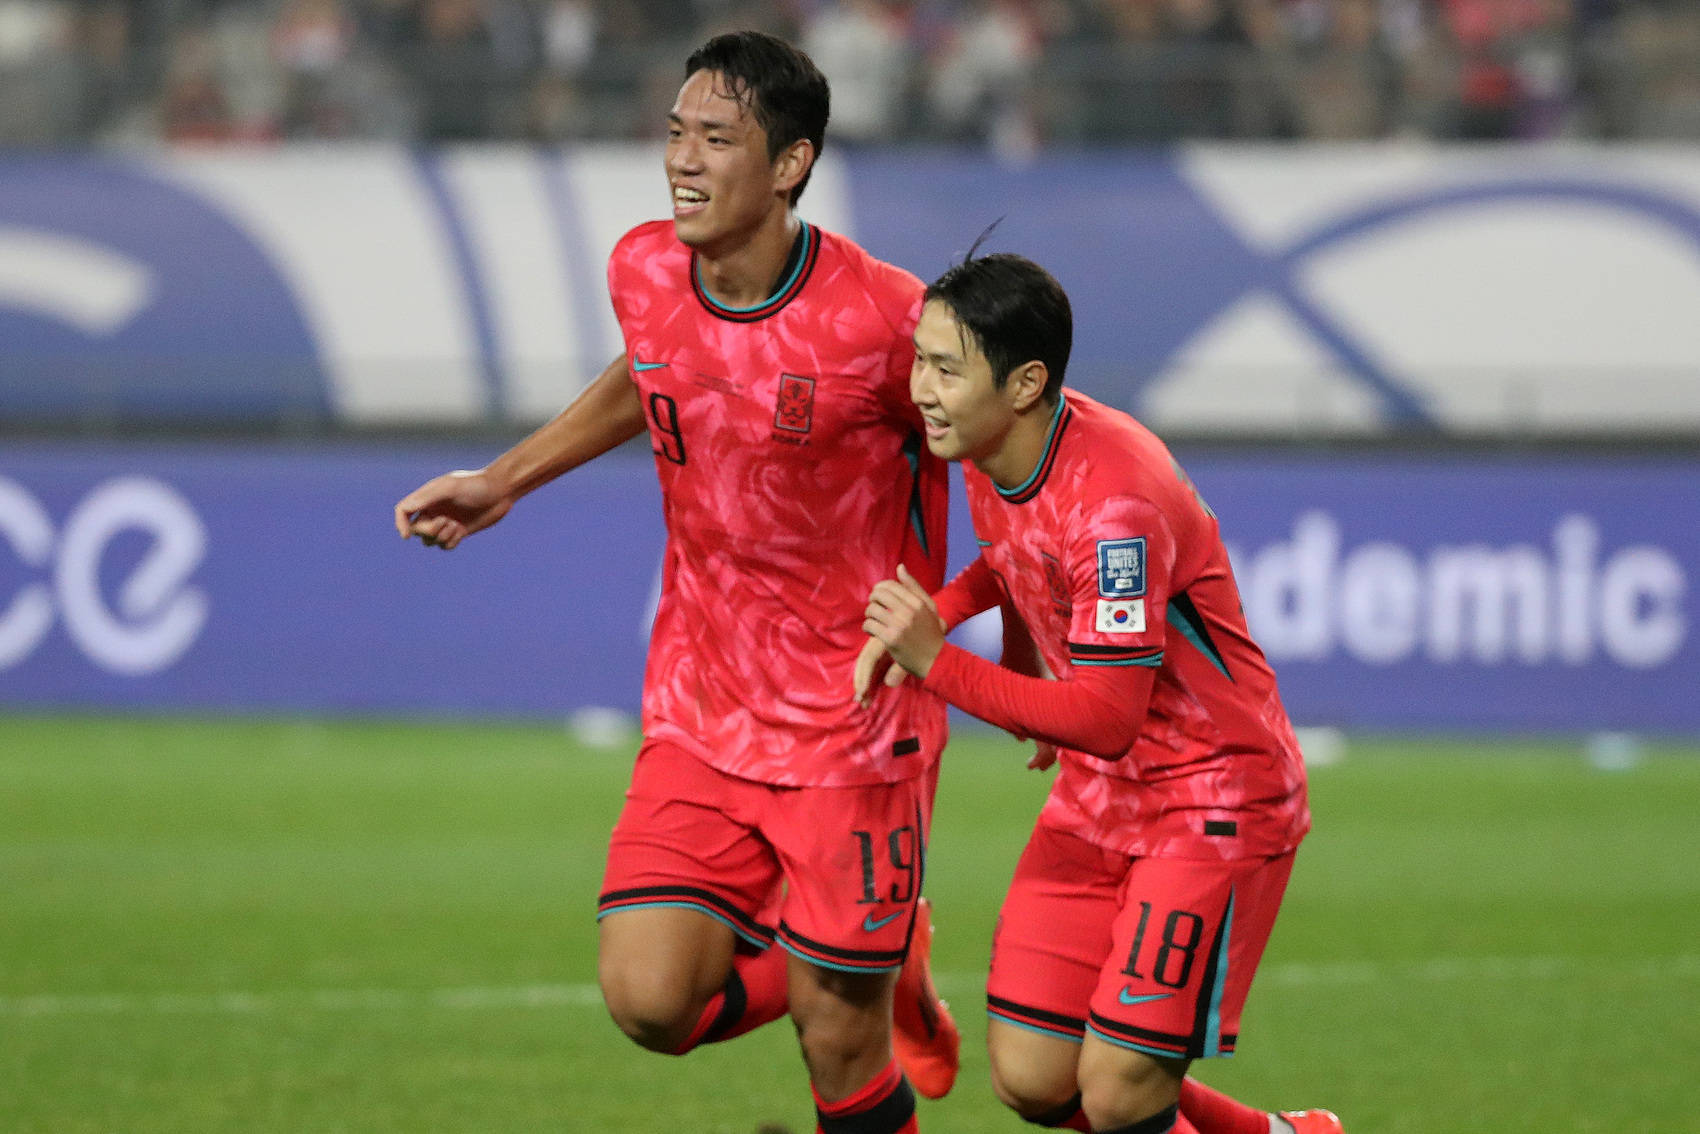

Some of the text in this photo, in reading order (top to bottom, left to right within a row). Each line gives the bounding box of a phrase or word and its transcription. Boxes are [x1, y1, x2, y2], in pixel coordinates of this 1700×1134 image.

[650, 392, 687, 465] 9
[1228, 510, 1687, 668] demic
[852, 826, 916, 904] 19
[1120, 901, 1204, 989] 18
